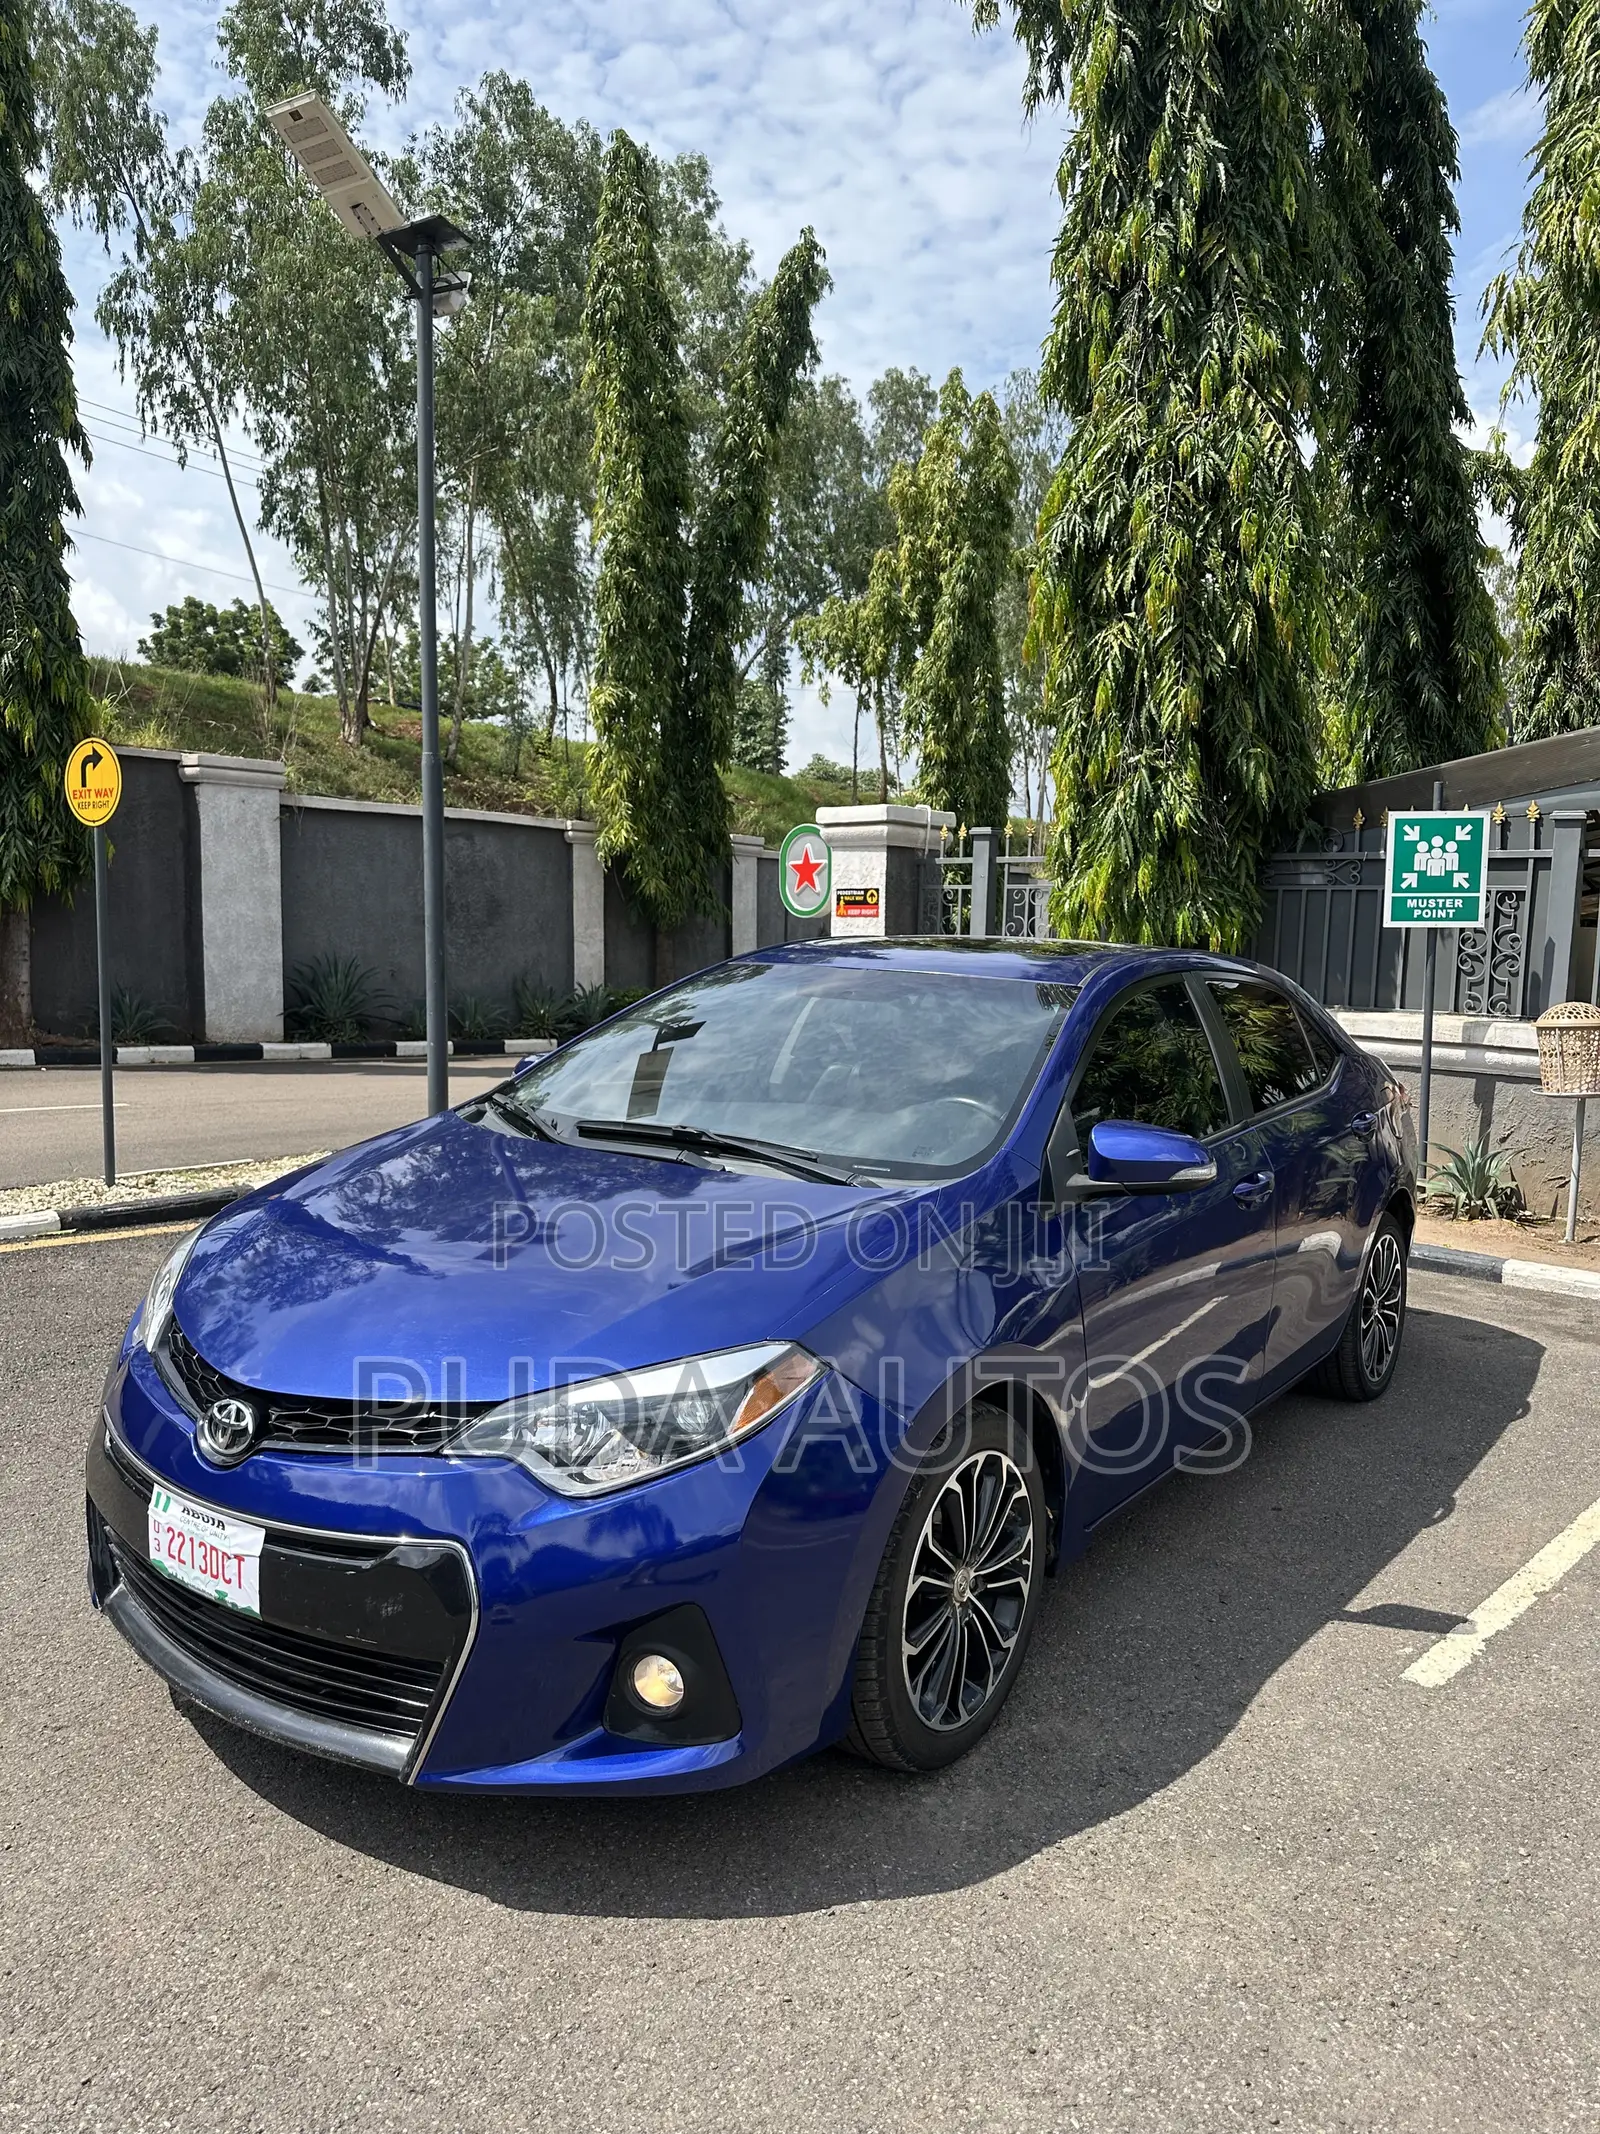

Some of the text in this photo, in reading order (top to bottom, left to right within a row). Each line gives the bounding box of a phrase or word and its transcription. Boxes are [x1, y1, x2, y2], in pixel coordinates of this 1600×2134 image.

[73, 788, 114, 800] EXIT WAY
[78, 800, 110, 810] KEEP RIGHT
[1406, 898, 1463, 908] MUSTER
[1413, 909, 1456, 918] POINT
[181, 1505, 226, 1531] ABUJA
[180, 1516, 229, 1541] CENTRE OF UNITY
[166, 1526, 246, 1590] 2213DCT
